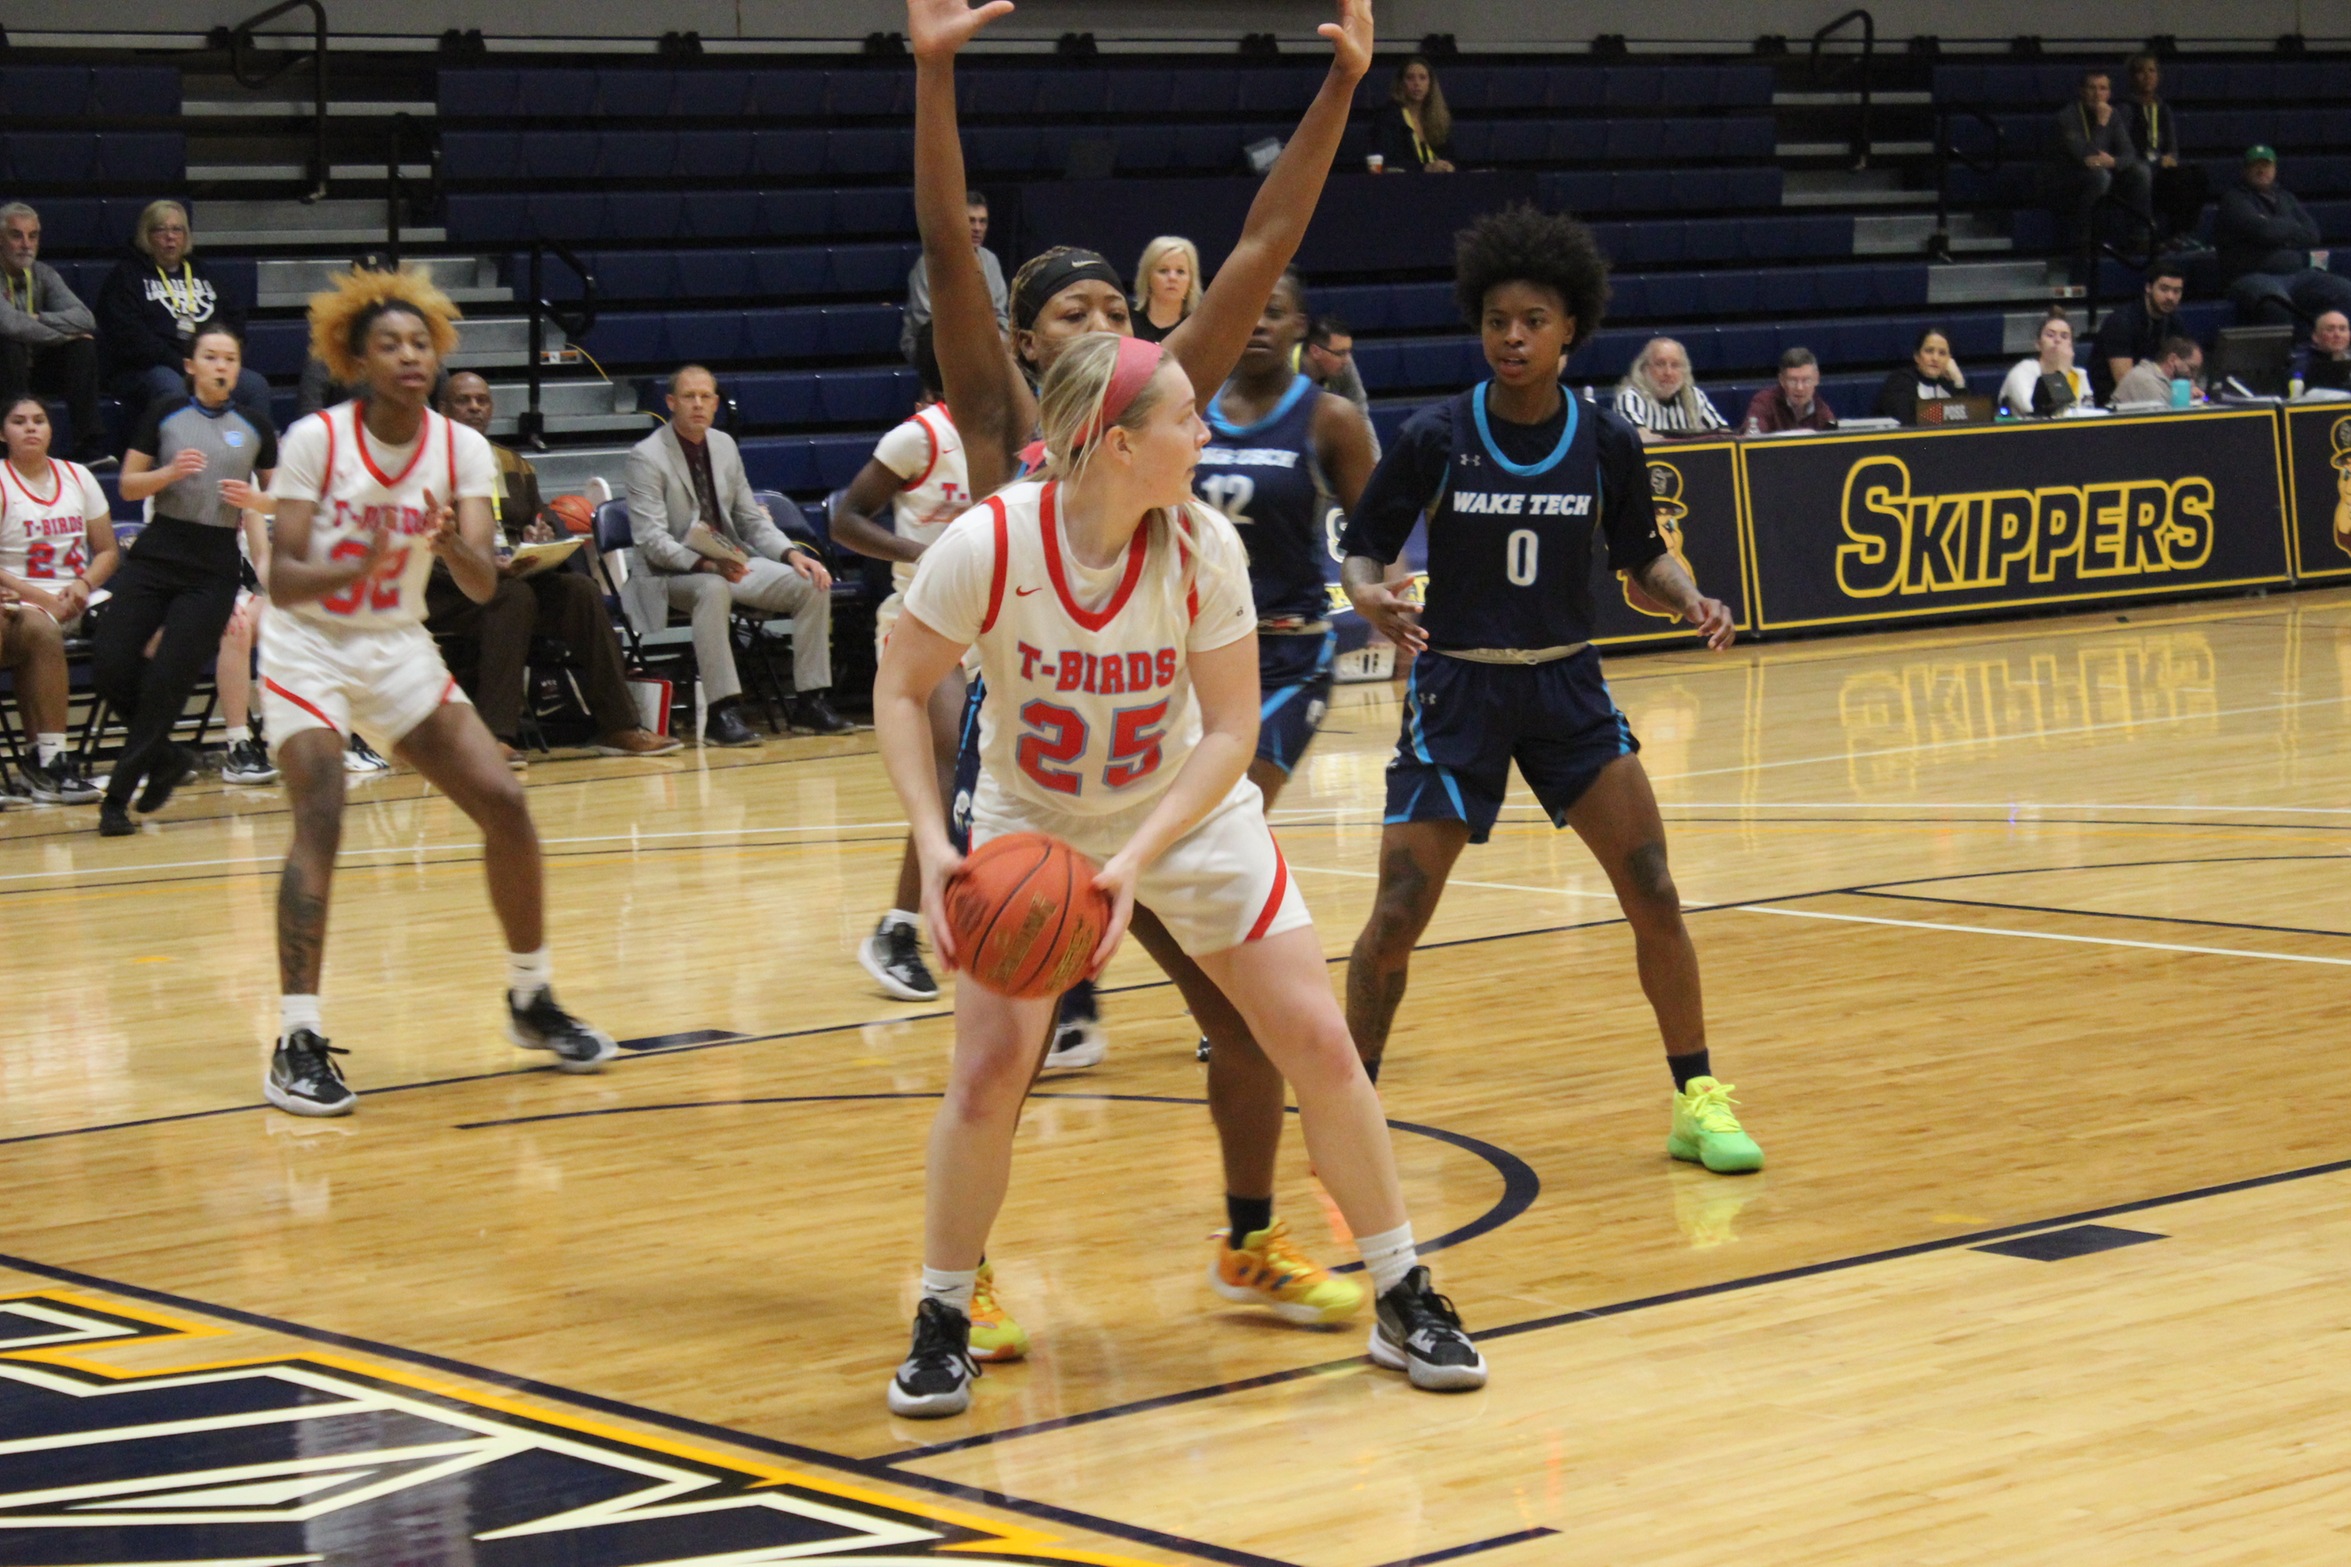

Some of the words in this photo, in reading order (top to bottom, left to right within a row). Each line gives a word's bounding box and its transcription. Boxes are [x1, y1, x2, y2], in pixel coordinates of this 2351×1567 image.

[1201, 474, 1255, 525] 12
[1453, 491, 1526, 515] WAKE
[1529, 493, 1592, 516] TECH
[23, 516, 84, 537] T-BIRDS
[1835, 455, 2214, 598] SKIPPERS
[26, 537, 85, 578] 24
[1507, 529, 1539, 587] 0
[1017, 640, 1177, 695] T-BIRDS
[1015, 697, 1171, 797] 25
